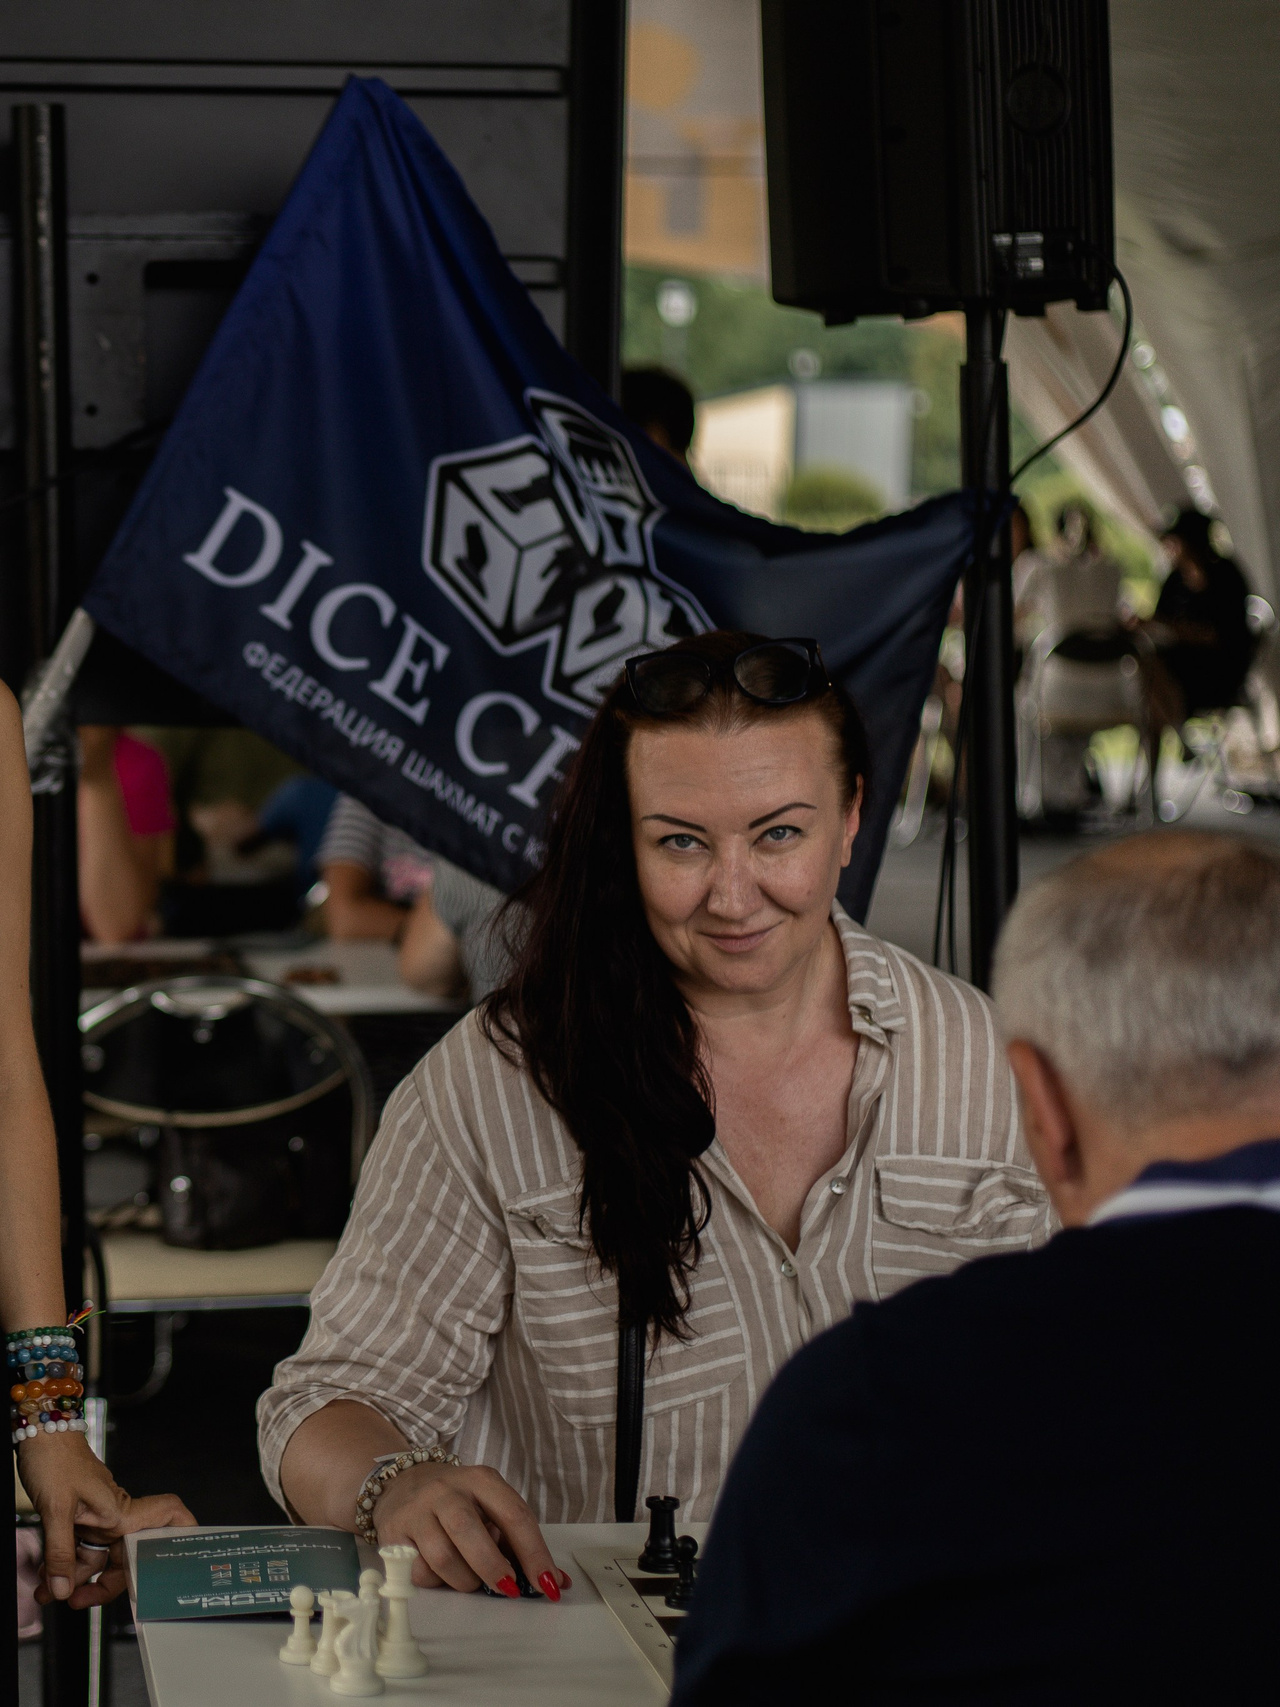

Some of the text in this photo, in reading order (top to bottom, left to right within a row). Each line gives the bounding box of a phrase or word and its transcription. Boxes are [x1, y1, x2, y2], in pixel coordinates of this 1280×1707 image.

[183, 486, 450, 726] DICE
[242, 641, 406, 766] ФЕДЕРАЦИЯ
[401, 750, 504, 837] ШАХМАТ
[501, 823, 524, 854] С
[172, 1534, 240, 1543] BetBoom
[156, 1544, 342, 1557] ИНТЕЛЛЕКТУАЛА
[198, 1548, 300, 1559] ПАСПОРТ
